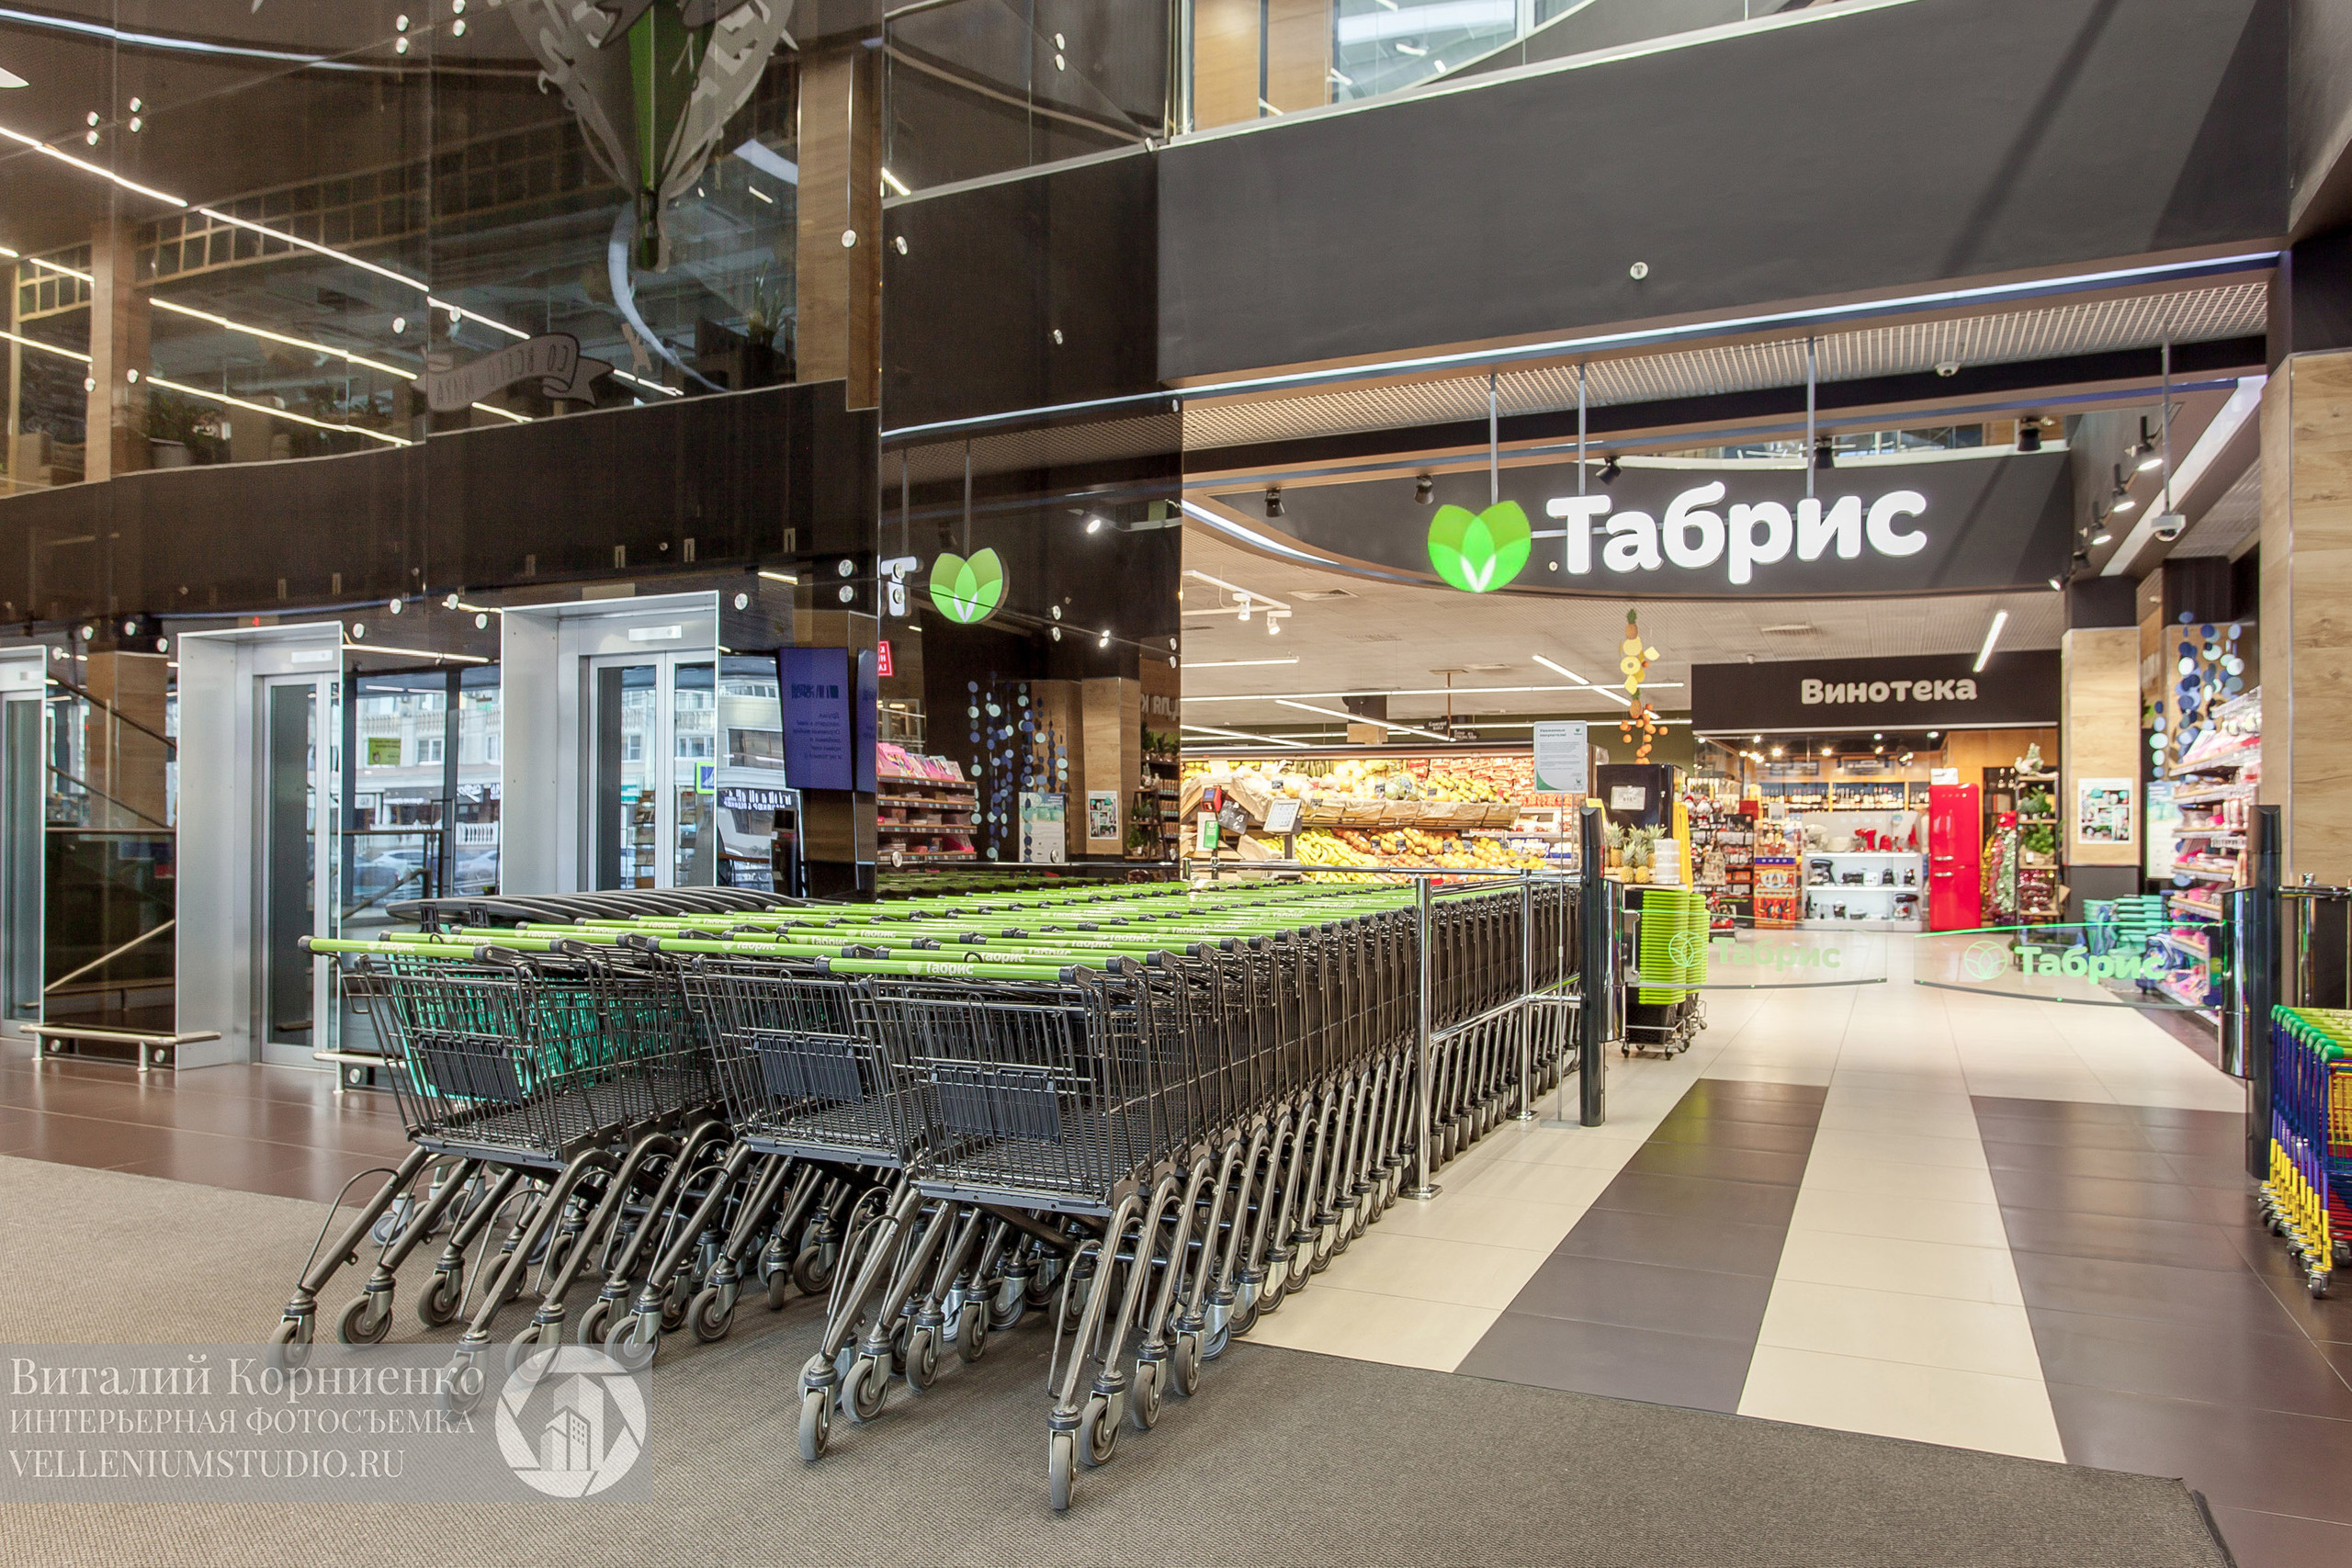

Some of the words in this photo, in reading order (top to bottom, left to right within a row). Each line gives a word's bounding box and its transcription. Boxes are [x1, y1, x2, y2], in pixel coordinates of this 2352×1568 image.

[1545, 481, 1928, 585] Табрис
[1801, 678, 1977, 705] Винотека
[1713, 936, 1841, 971] Табрис
[2014, 946, 2167, 985] Табрис
